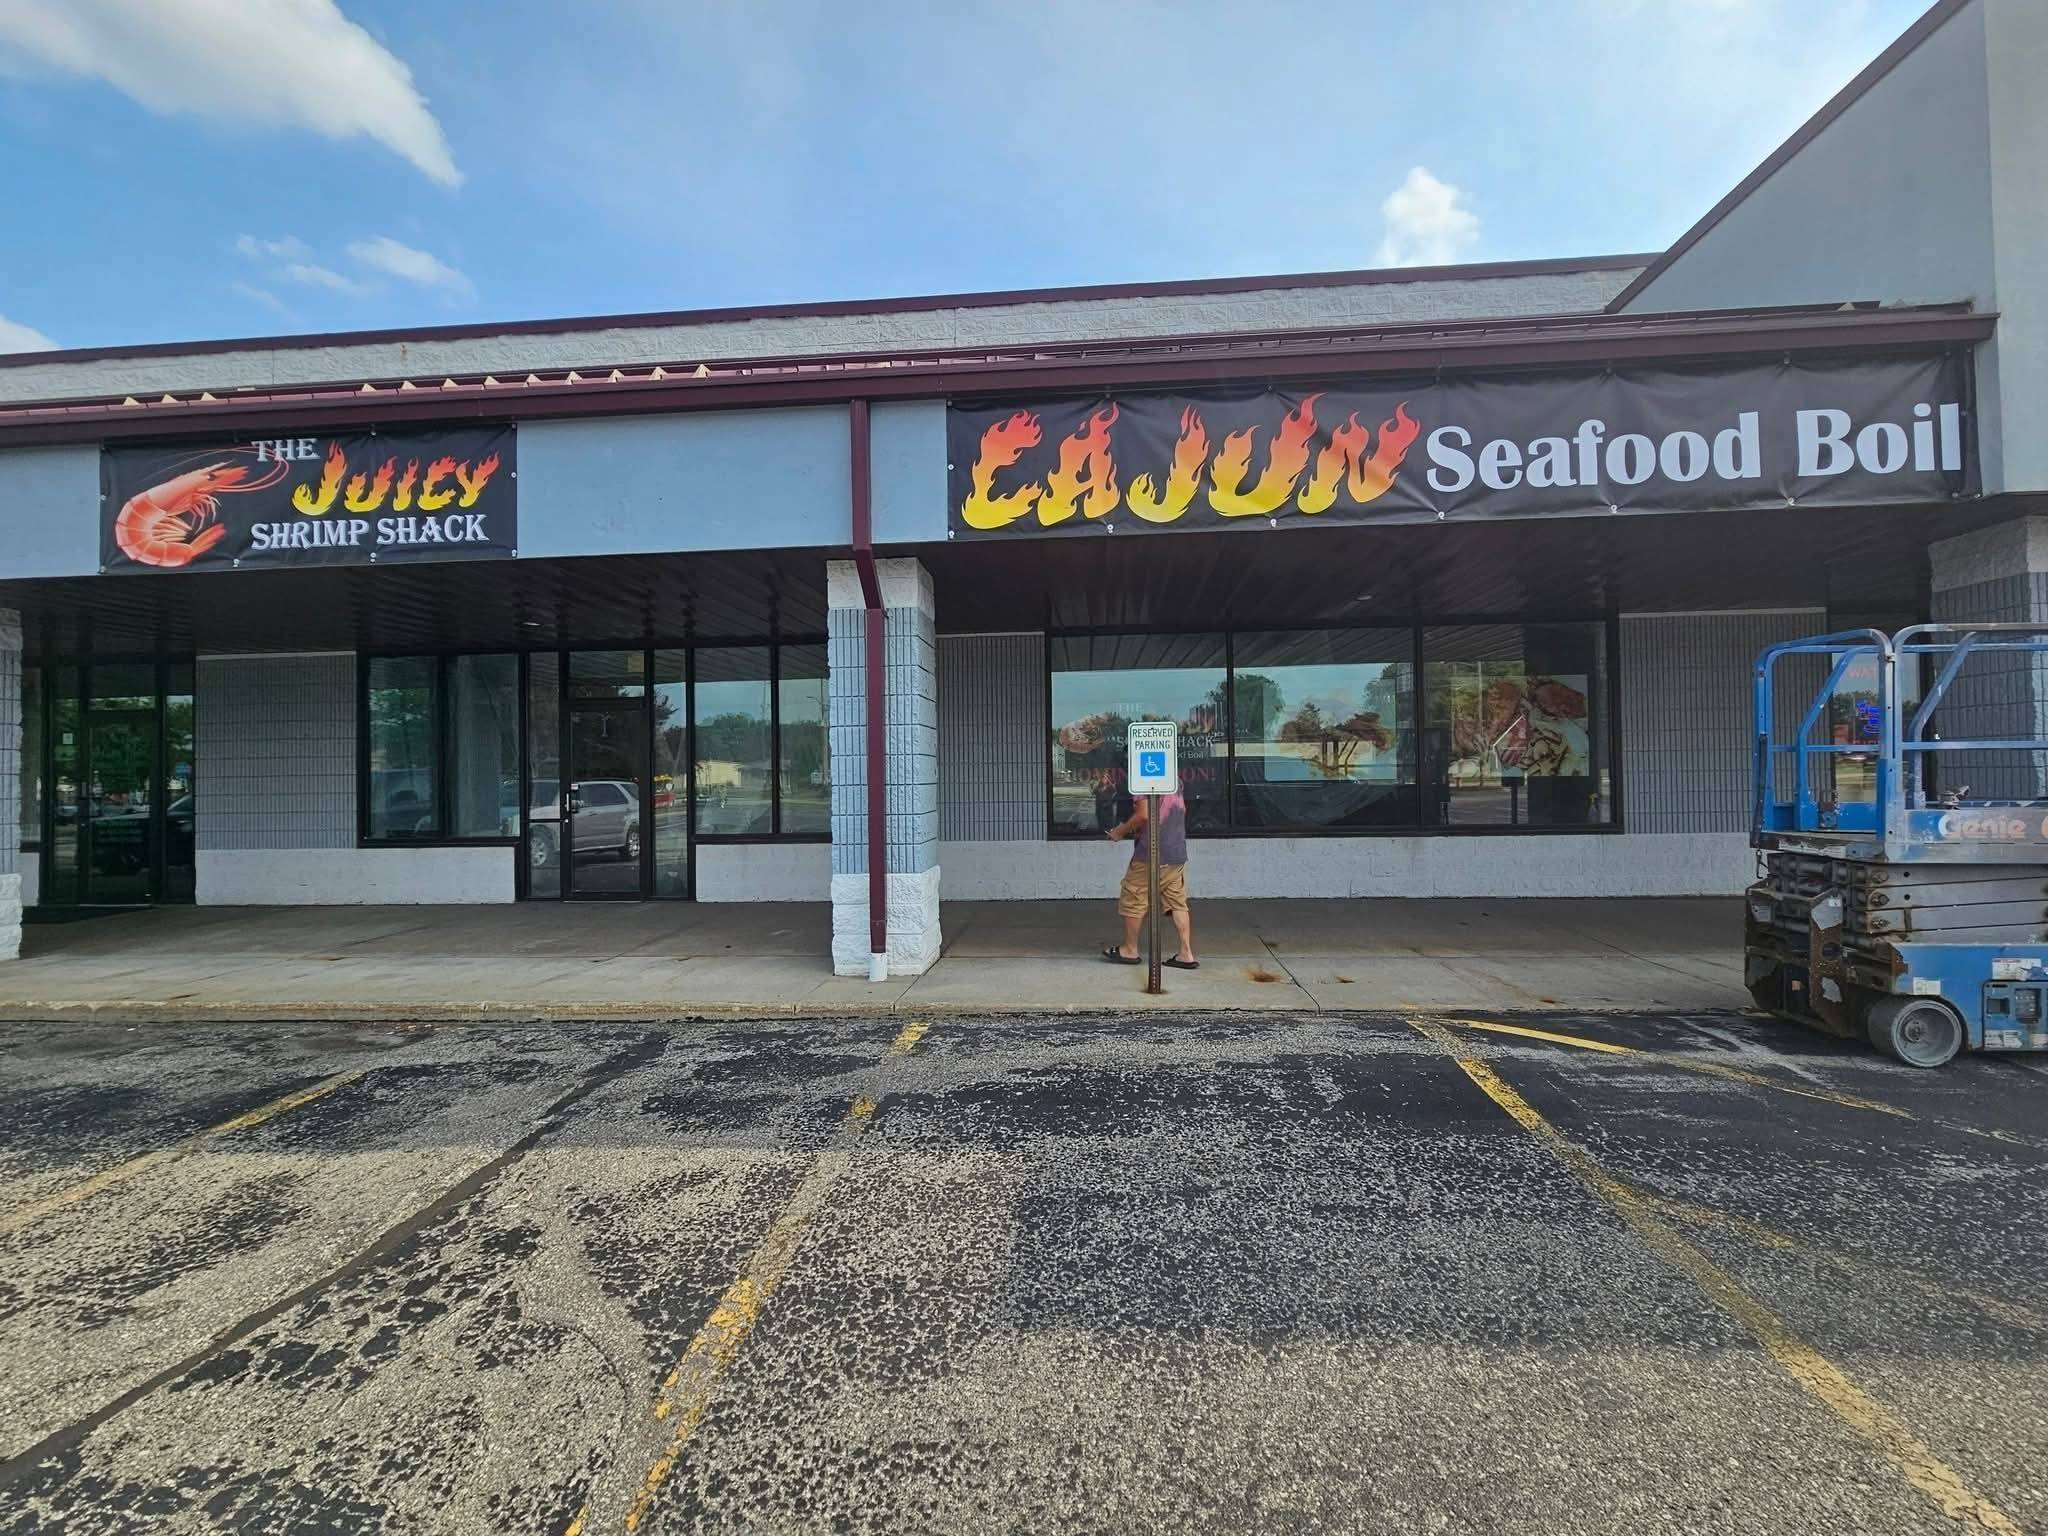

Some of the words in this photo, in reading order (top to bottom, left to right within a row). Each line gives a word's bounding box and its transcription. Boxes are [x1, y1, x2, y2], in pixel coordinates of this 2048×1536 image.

[251, 437, 321, 463] THE
[961, 391, 1422, 530] CAJUN
[1425, 410, 1761, 493] Seafood
[1796, 402, 1962, 478] Boil
[250, 518, 370, 551] SHRIMP
[376, 513, 490, 546] SHACK
[1132, 728, 1173, 738] RESERVED
[1135, 740, 1170, 750] PARKING
[1937, 814, 2027, 840] Genie
